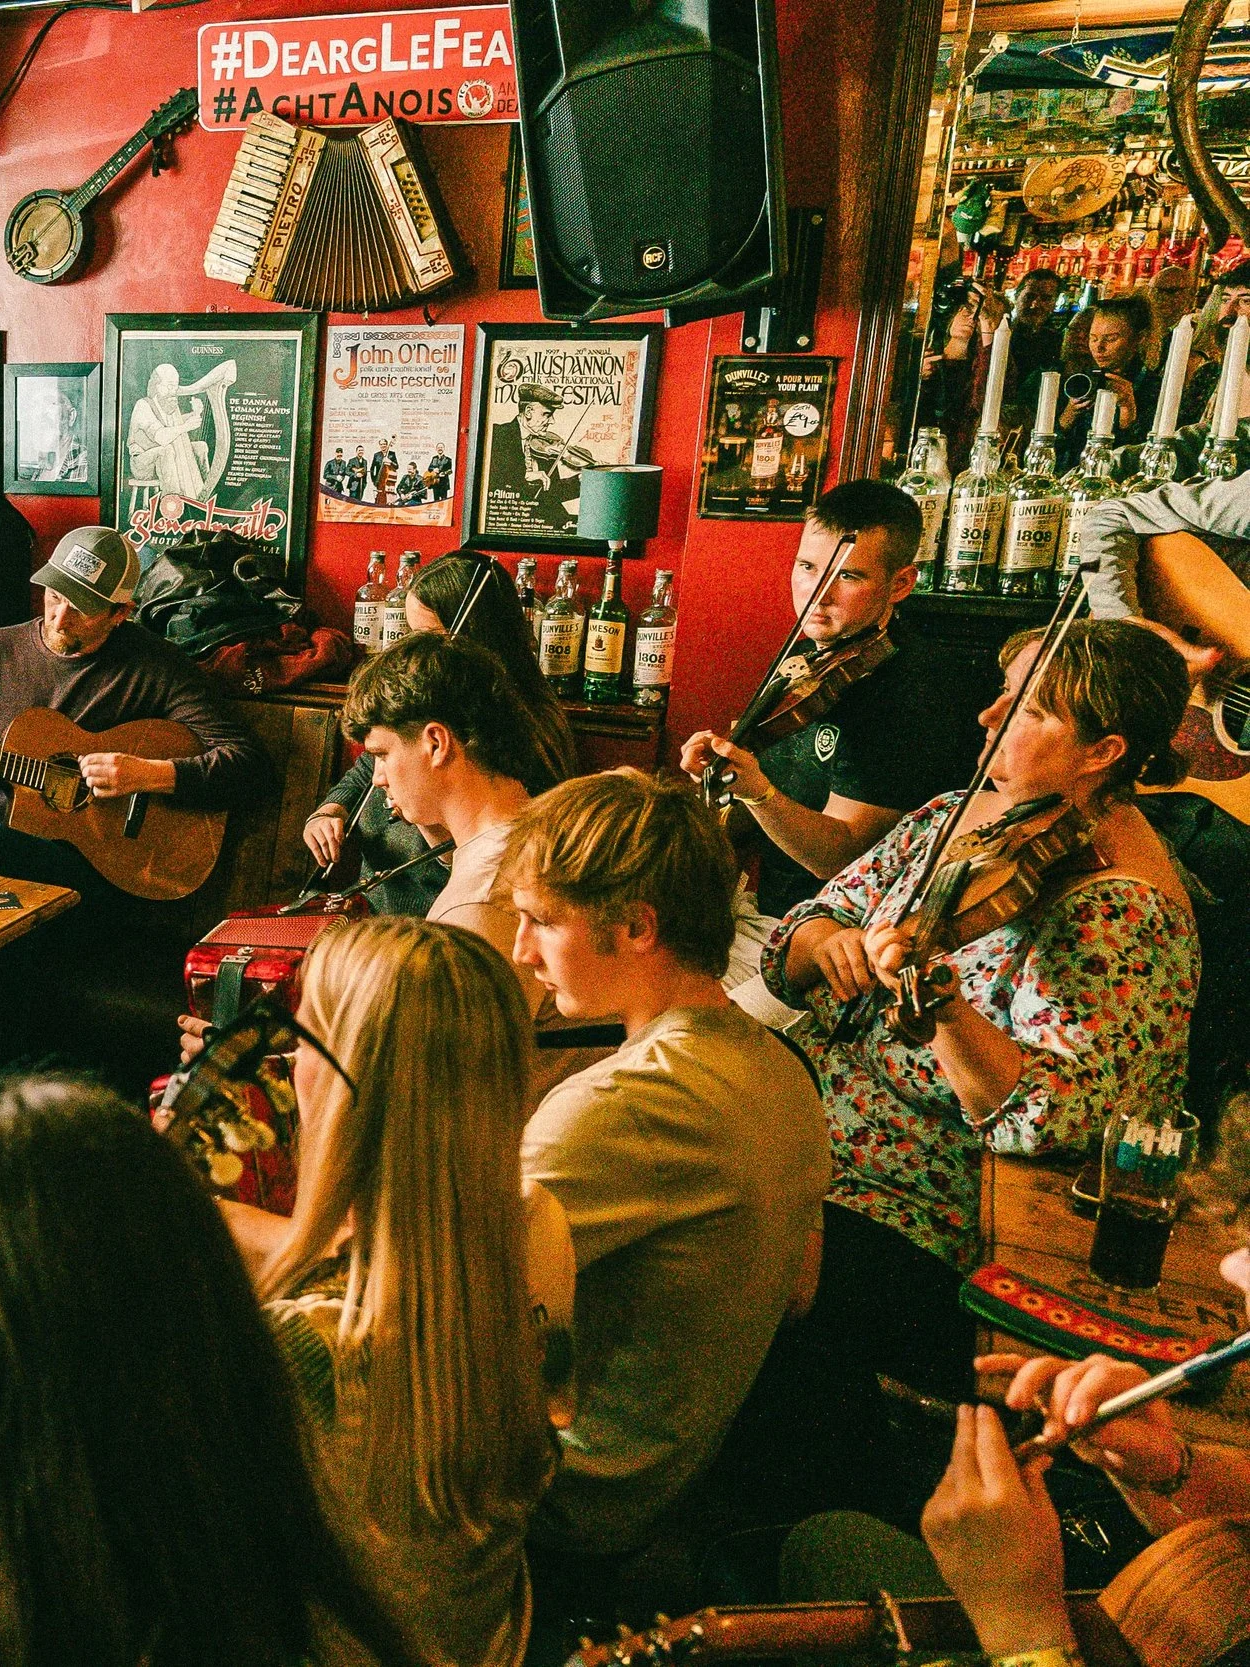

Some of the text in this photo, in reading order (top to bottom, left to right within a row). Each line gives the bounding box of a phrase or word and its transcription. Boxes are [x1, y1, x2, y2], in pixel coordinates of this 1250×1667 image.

[272, 182, 302, 247] PIETRO
[646, 252, 663, 263] RCF
[191, 346, 224, 355] GUINNESS
[333, 343, 457, 390] John O'Neill
[360, 374, 398, 387] music
[725, 369, 770, 384] DUNVILLE'S
[776, 375, 823, 383] A POUR WITH
[778, 384, 819, 392] YOUR PLAIN
[230, 406, 290, 415] TOMMY SANDS
[494, 489, 515, 499] Altan
[1017, 529, 1051, 542] 1808
[545, 643, 571, 656] 1808
[638, 652, 666, 664] 1808
